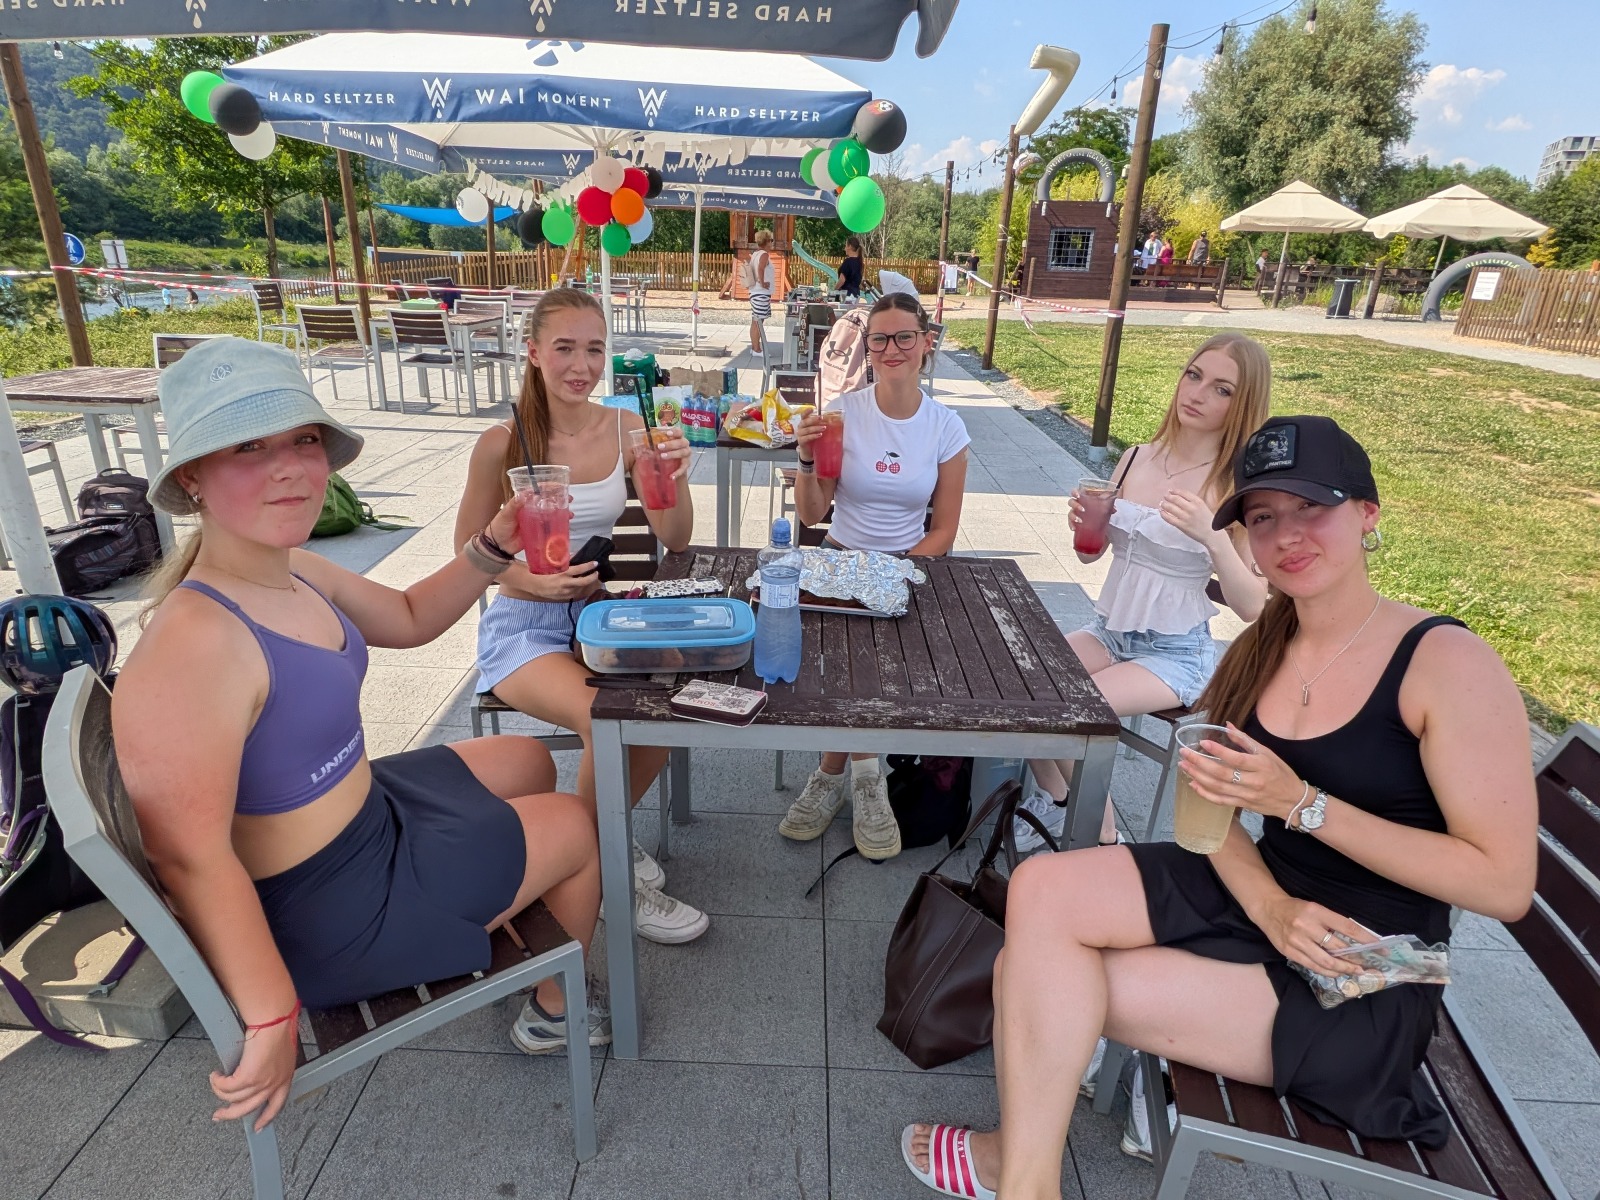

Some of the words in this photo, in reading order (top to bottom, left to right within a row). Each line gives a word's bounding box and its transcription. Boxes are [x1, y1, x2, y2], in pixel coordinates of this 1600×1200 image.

[269, 91, 315, 104] HARD
[324, 93, 395, 104] SELTZER
[475, 87, 524, 105] WAI
[537, 91, 611, 109] MOMENT
[695, 105, 740, 118] HARD
[748, 108, 820, 122] SELTZER
[1268, 460, 1292, 468] PANTHER
